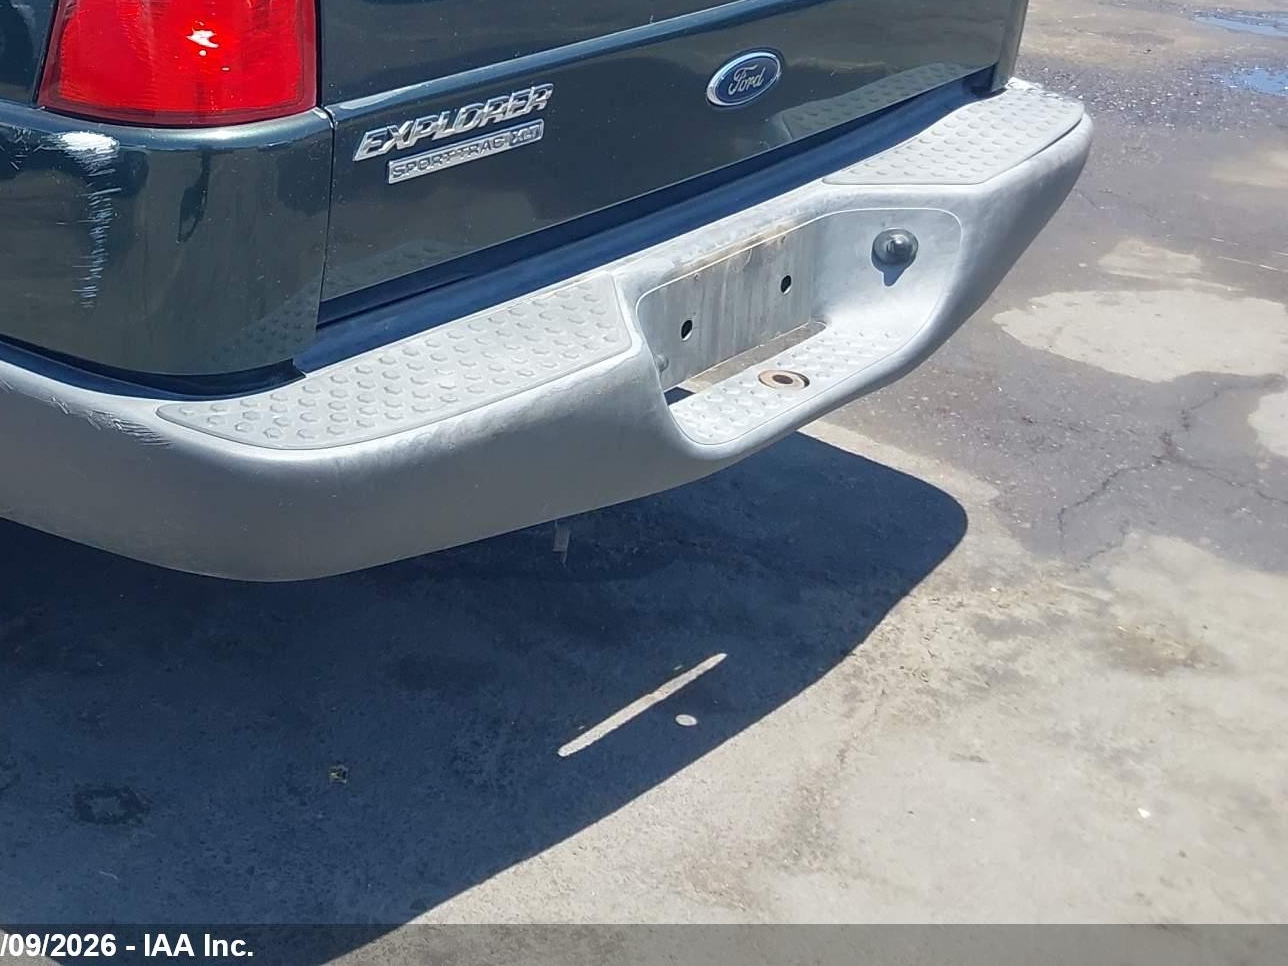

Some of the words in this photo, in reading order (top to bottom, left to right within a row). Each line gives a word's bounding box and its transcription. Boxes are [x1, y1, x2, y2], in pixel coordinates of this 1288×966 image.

[727, 64, 767, 96] Ford
[353, 83, 554, 162] EXPLORER
[391, 151, 457, 179] SPORT
[457, 135, 506, 162] TRAC
[511, 125, 540, 145] XLT
